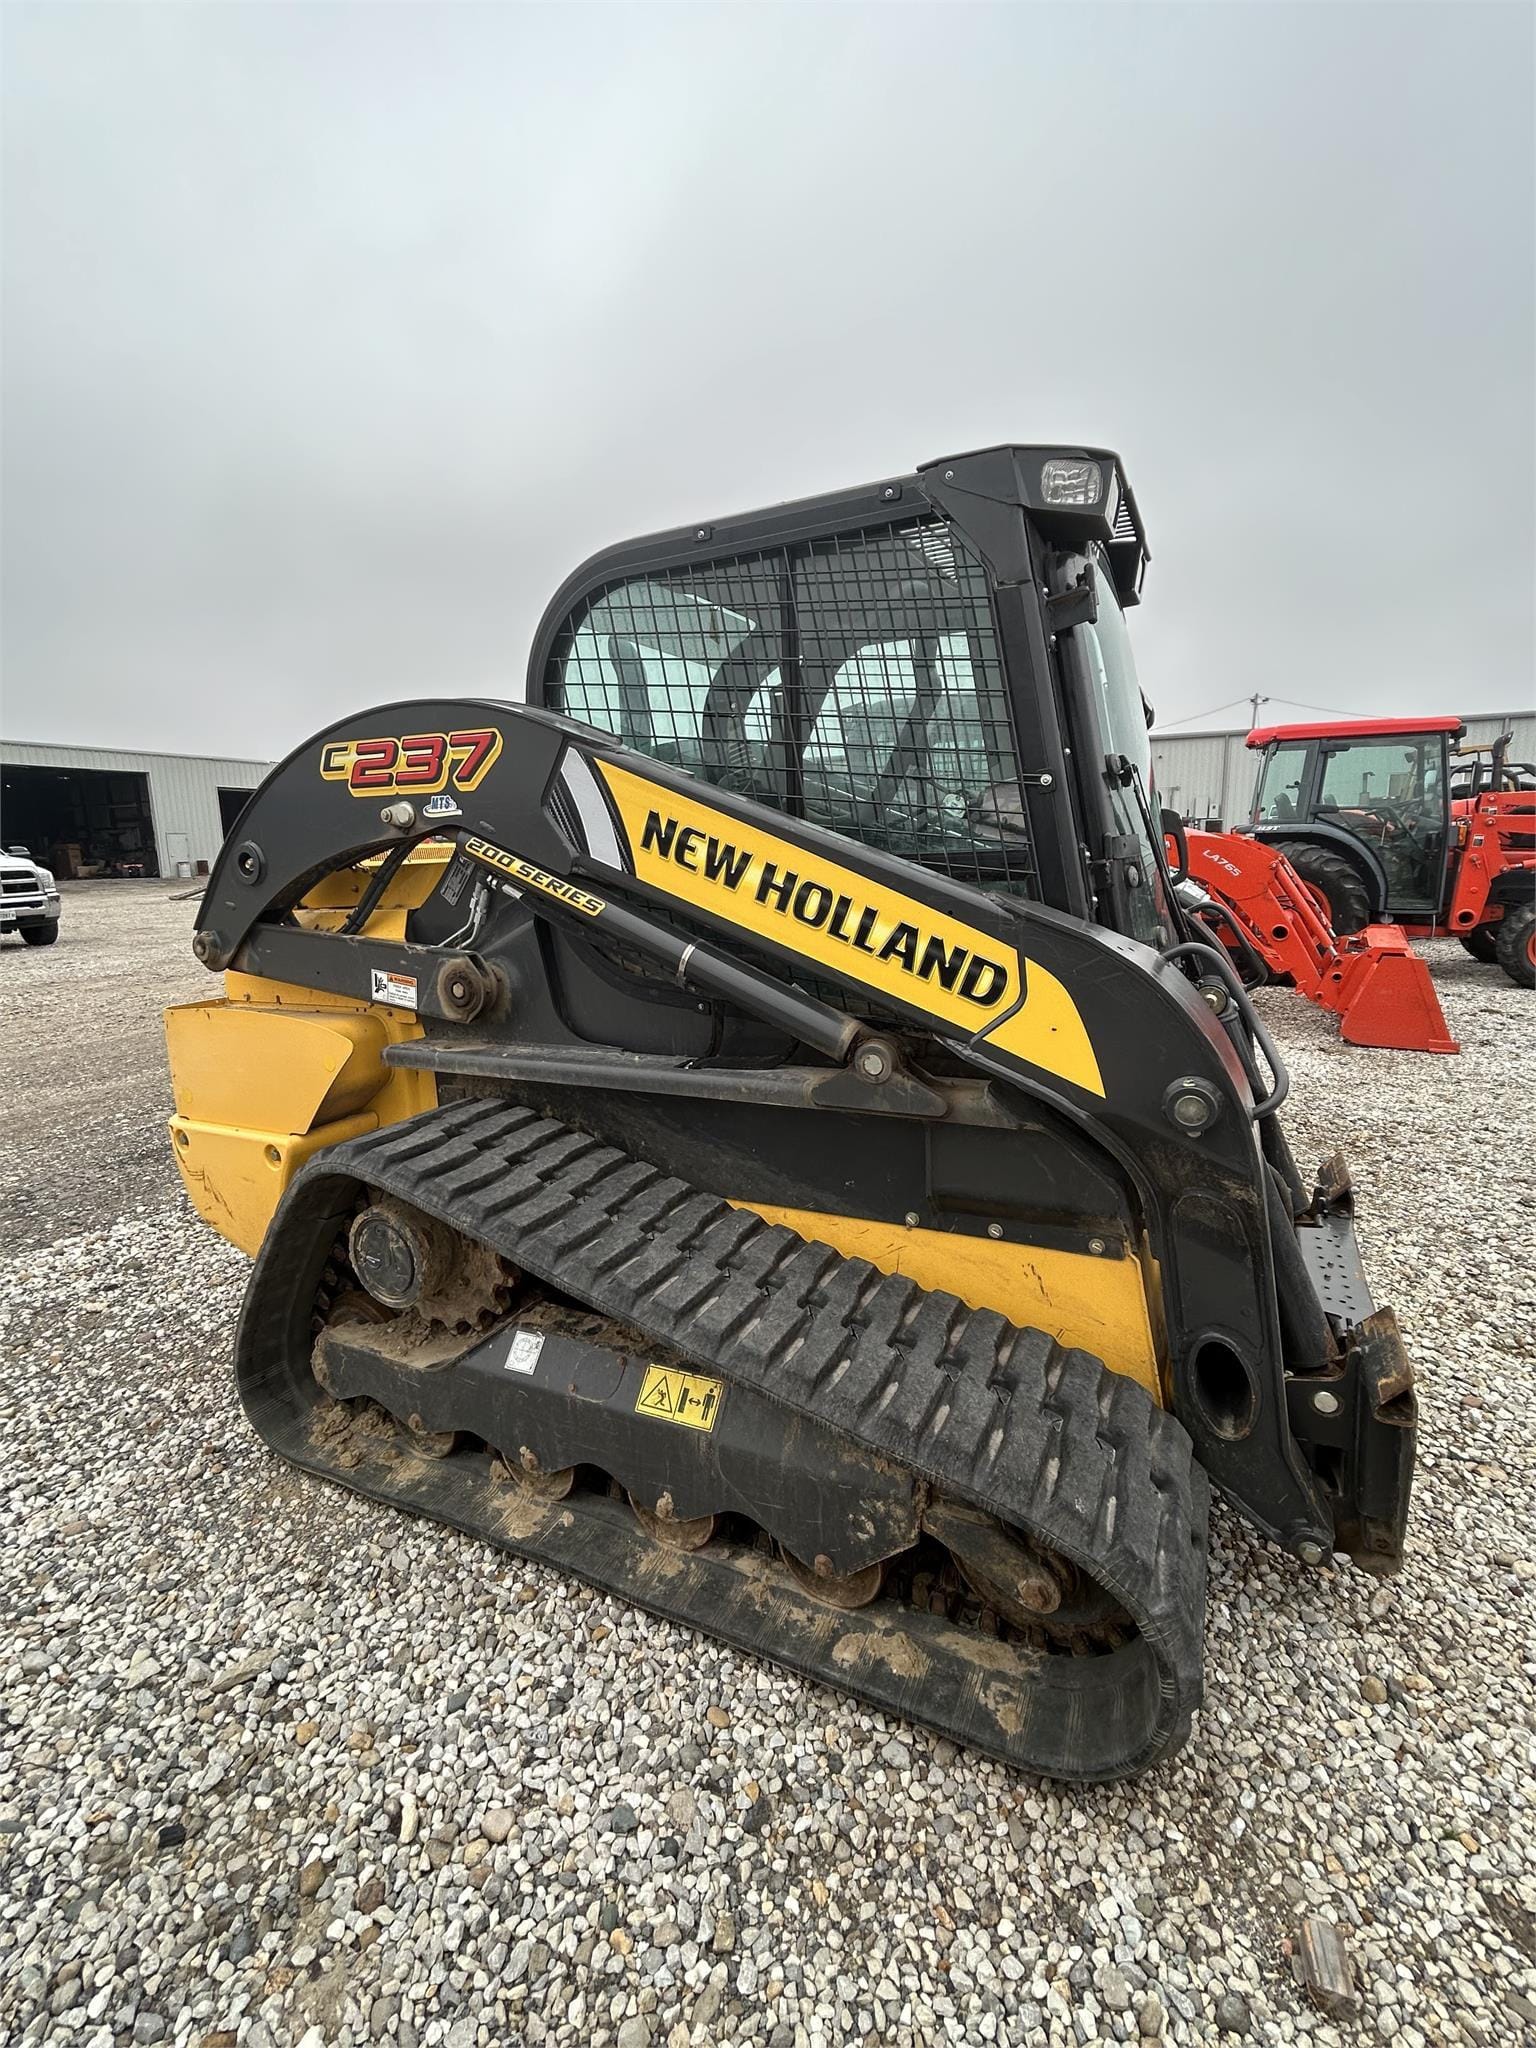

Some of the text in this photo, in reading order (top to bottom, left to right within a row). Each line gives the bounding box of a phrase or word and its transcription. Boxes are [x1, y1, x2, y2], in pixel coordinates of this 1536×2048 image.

[322, 730, 499, 789] C237
[431, 796, 451, 810] MTS
[467, 838, 515, 868] 200
[516, 864, 603, 911] SERIES
[1202, 849, 1242, 877] LA765
[641, 810, 1009, 1007] NEW HOLLAND
